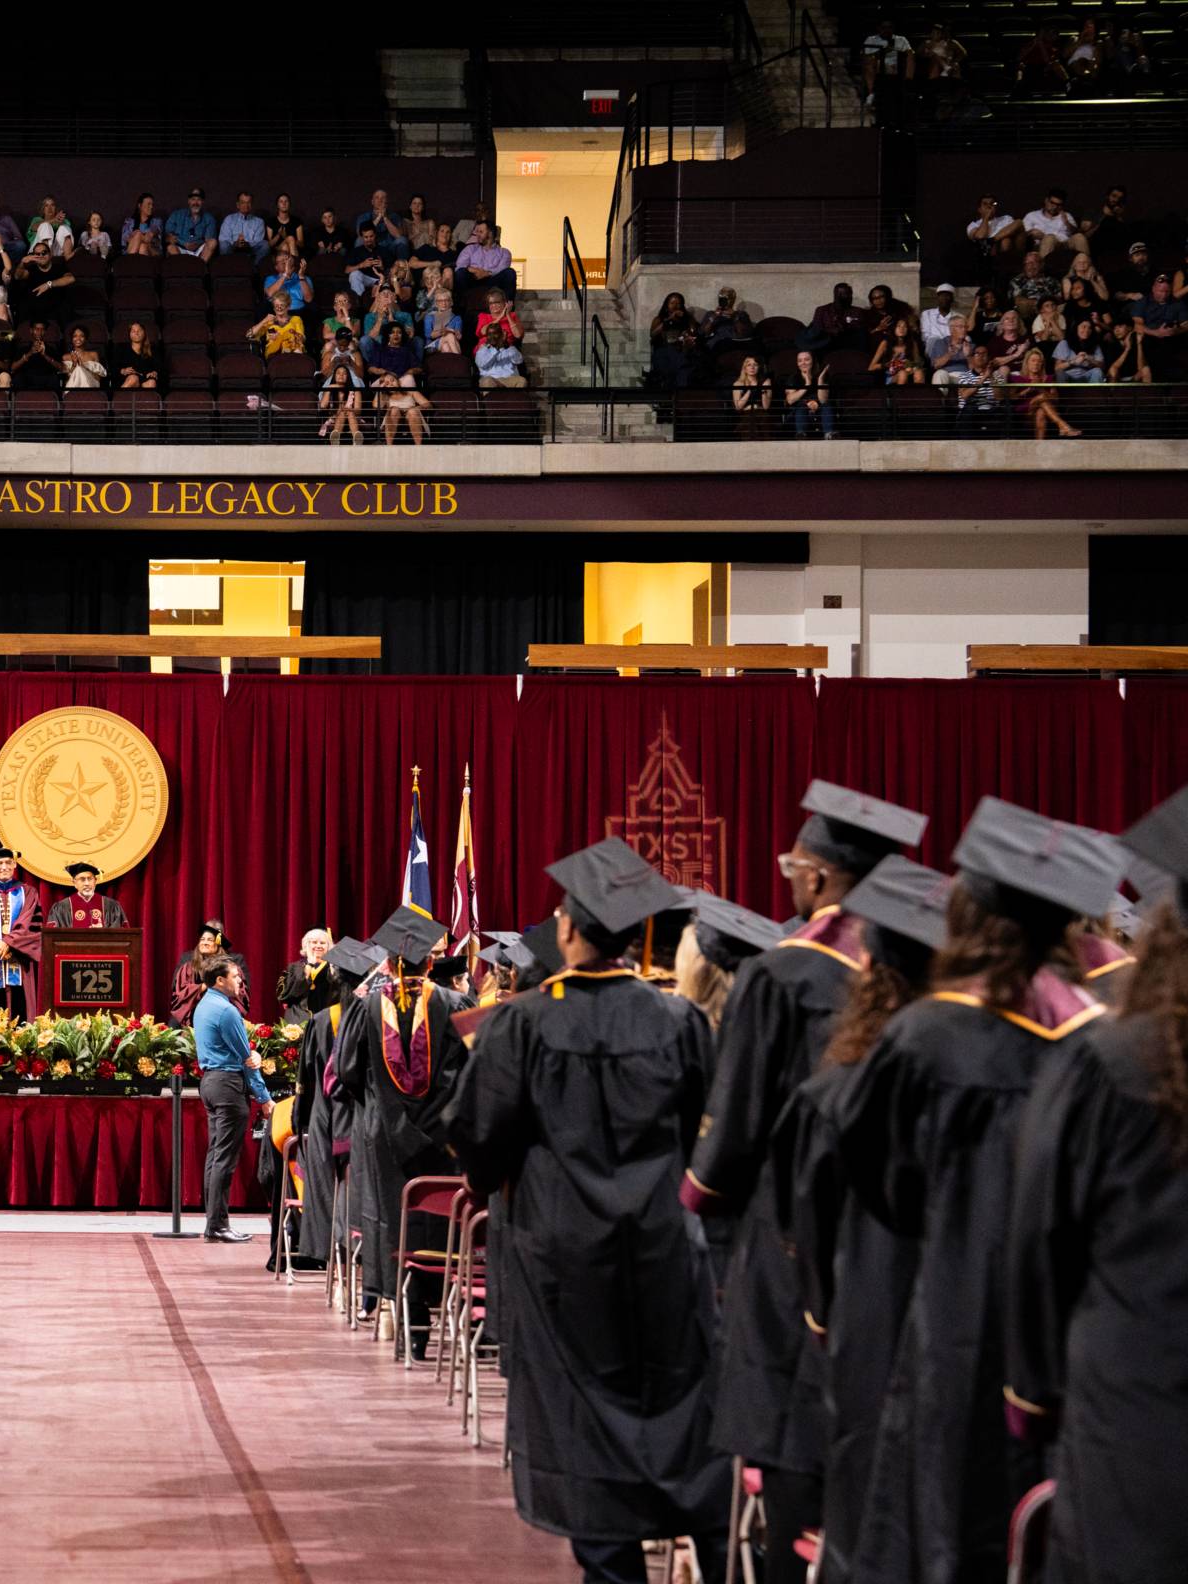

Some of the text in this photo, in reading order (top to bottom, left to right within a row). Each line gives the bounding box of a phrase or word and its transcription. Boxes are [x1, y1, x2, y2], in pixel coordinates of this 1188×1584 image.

[592, 98, 613, 113] EXIT
[521, 161, 541, 176] EXIT
[148, 482, 325, 515] LEGACY
[341, 483, 457, 515] CLUB
[2, 719, 157, 816] TEXAS STATE UNIVERSITY
[71, 969, 113, 994] 125
